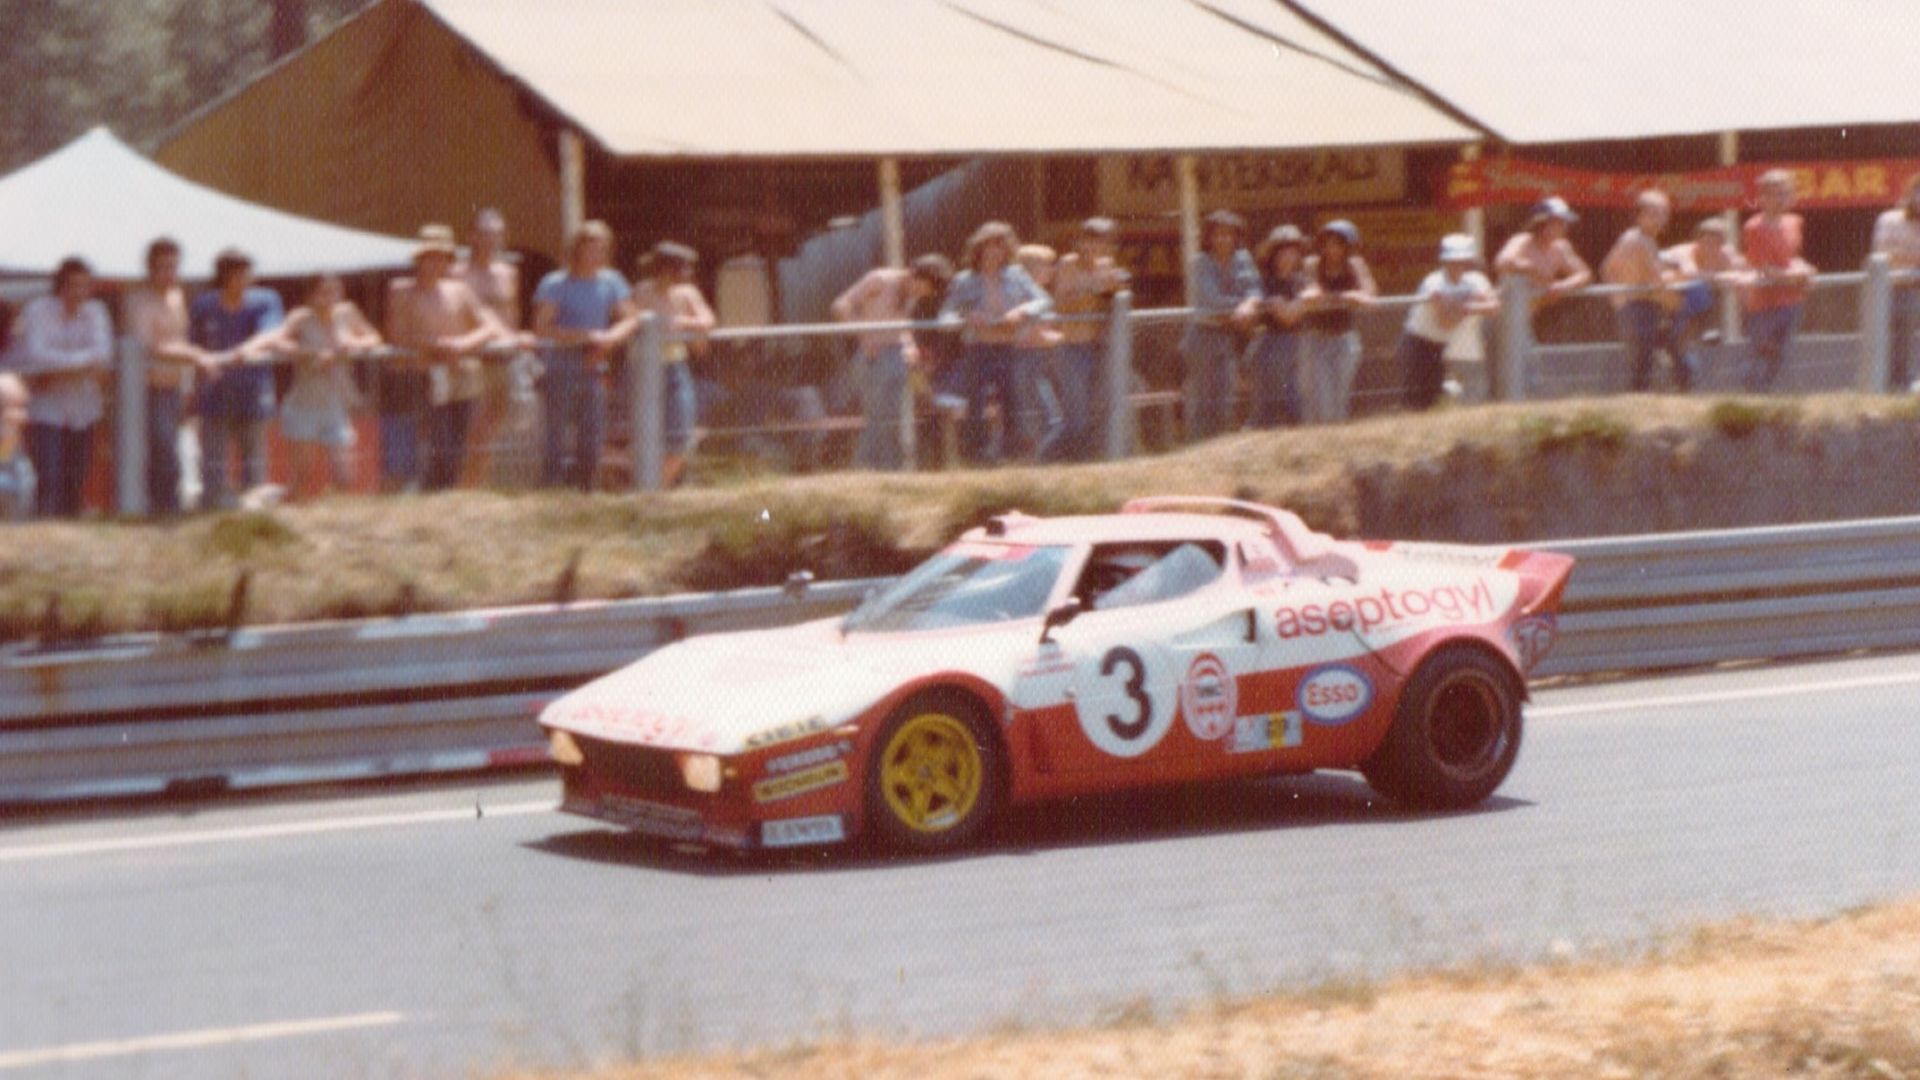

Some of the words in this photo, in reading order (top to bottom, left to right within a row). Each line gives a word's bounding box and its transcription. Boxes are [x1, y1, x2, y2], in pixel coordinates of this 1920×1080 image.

[1792, 165, 1888, 199] BAR
[1274, 575, 1495, 639] aseptogyl
[1100, 644, 1154, 742] 3
[1306, 682, 1358, 708] Esso
